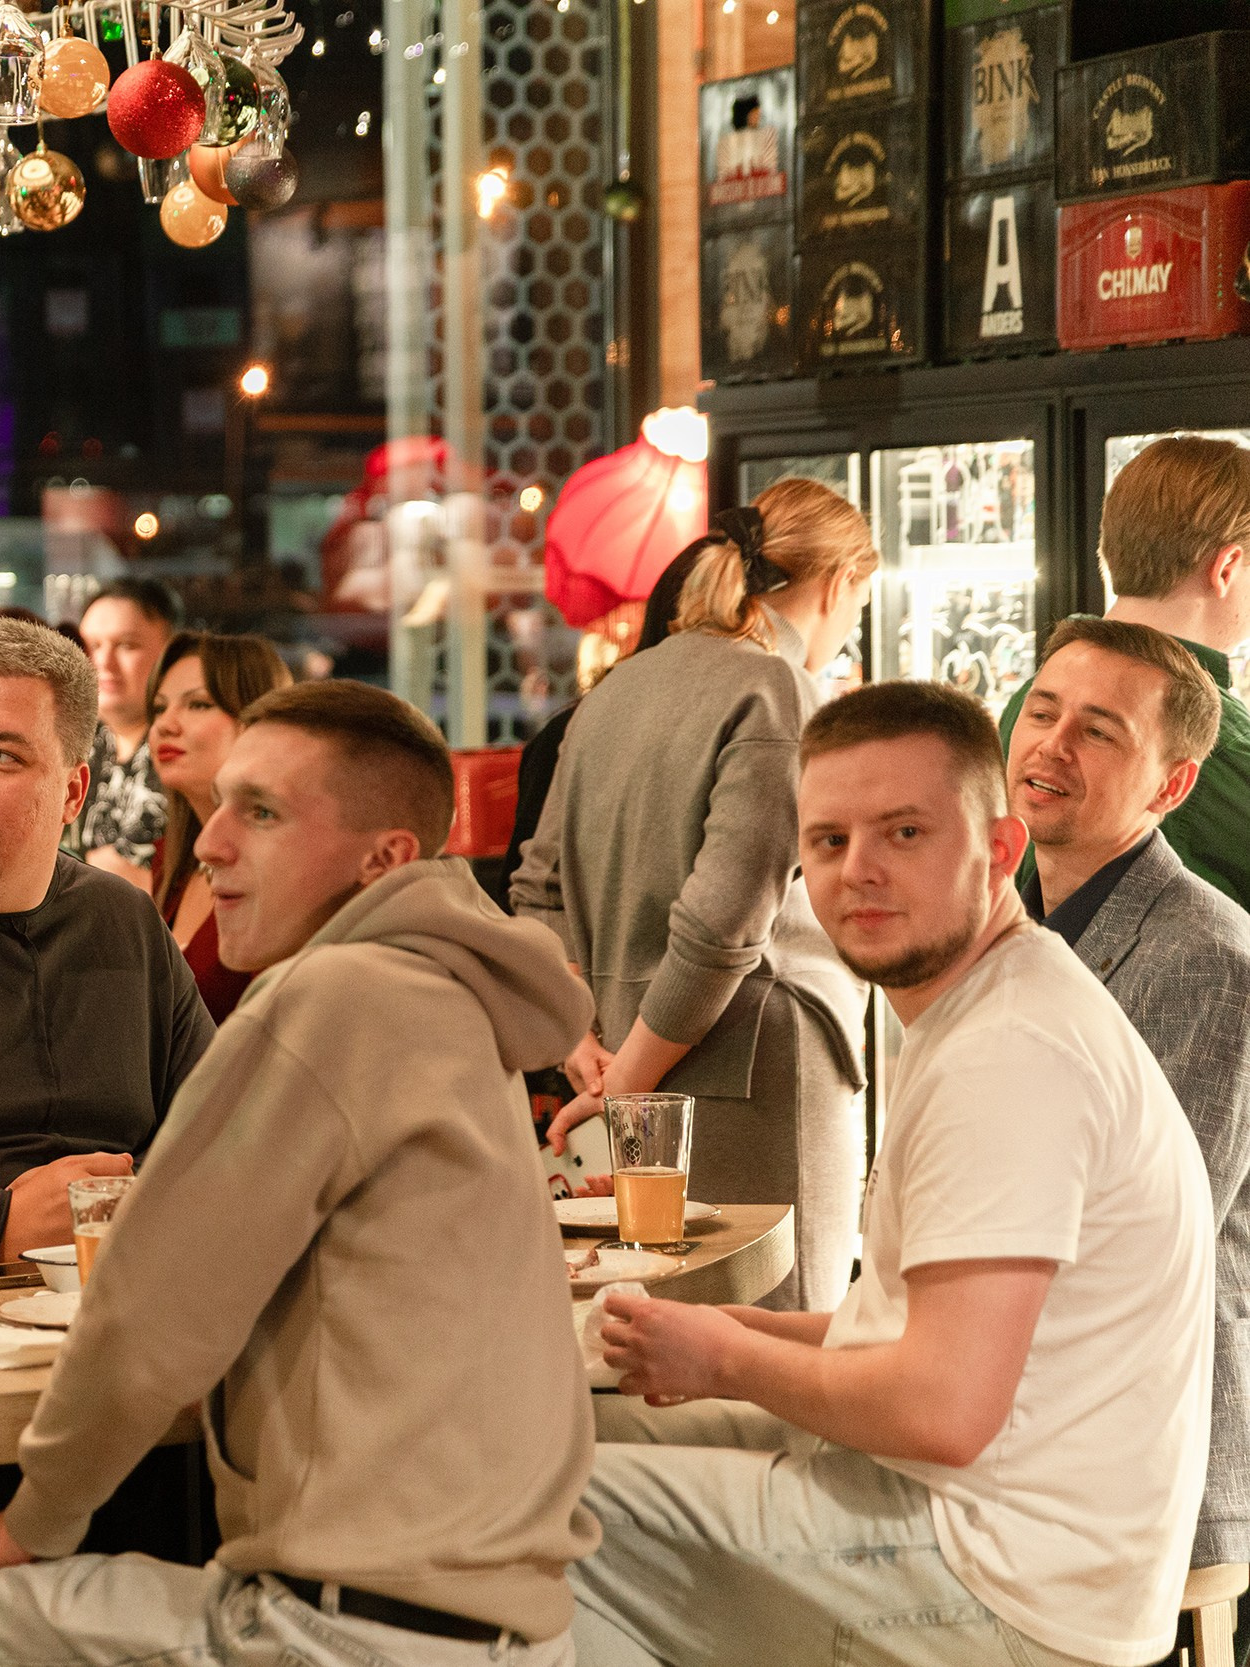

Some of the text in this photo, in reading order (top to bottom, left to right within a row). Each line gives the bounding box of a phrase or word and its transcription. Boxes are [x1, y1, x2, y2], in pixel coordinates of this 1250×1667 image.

[974, 57, 1040, 105] BINK
[982, 195, 1023, 313] A
[1097, 261, 1173, 301] CHIMAY
